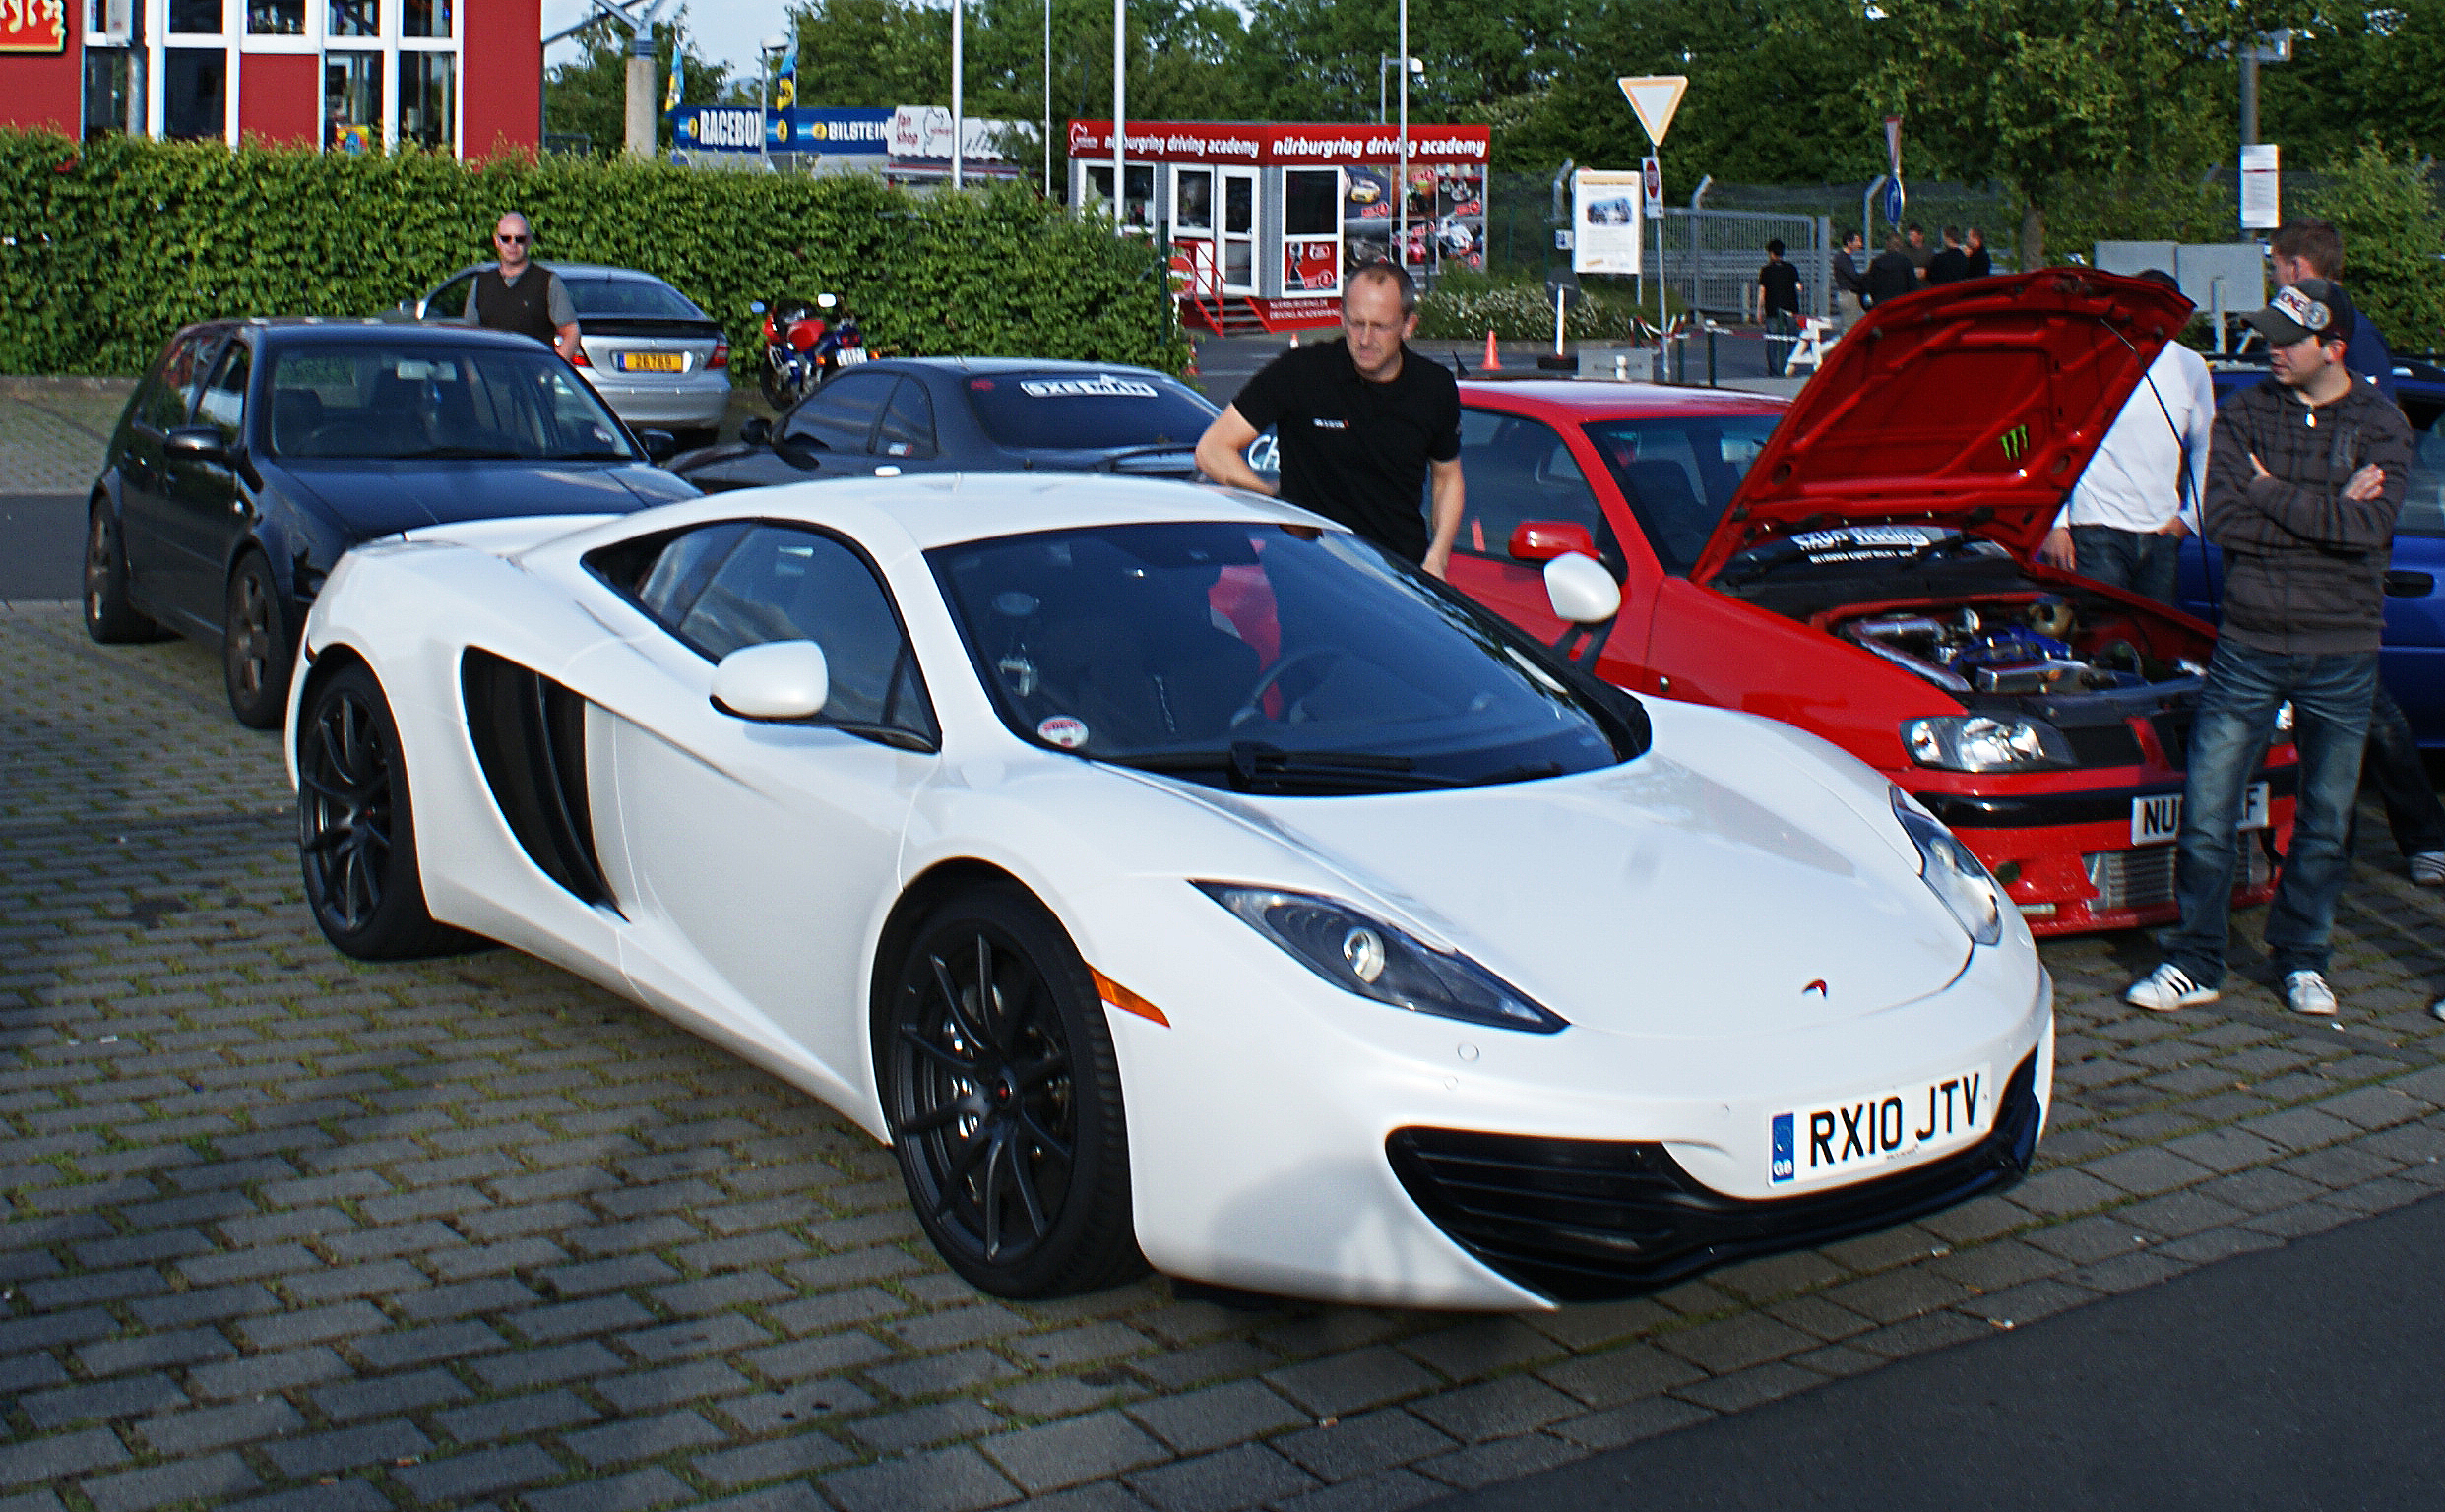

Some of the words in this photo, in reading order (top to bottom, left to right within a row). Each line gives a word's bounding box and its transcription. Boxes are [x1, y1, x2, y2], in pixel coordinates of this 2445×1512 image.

[1167, 134, 1206, 157] driving
[1208, 137, 1260, 159] academy
[1272, 136, 1363, 158] nürburgring
[1366, 136, 1418, 158] drivig
[1420, 136, 1486, 158] academy
[1809, 1096, 1902, 1167] RX10
[1915, 1072, 1980, 1142] JTV
